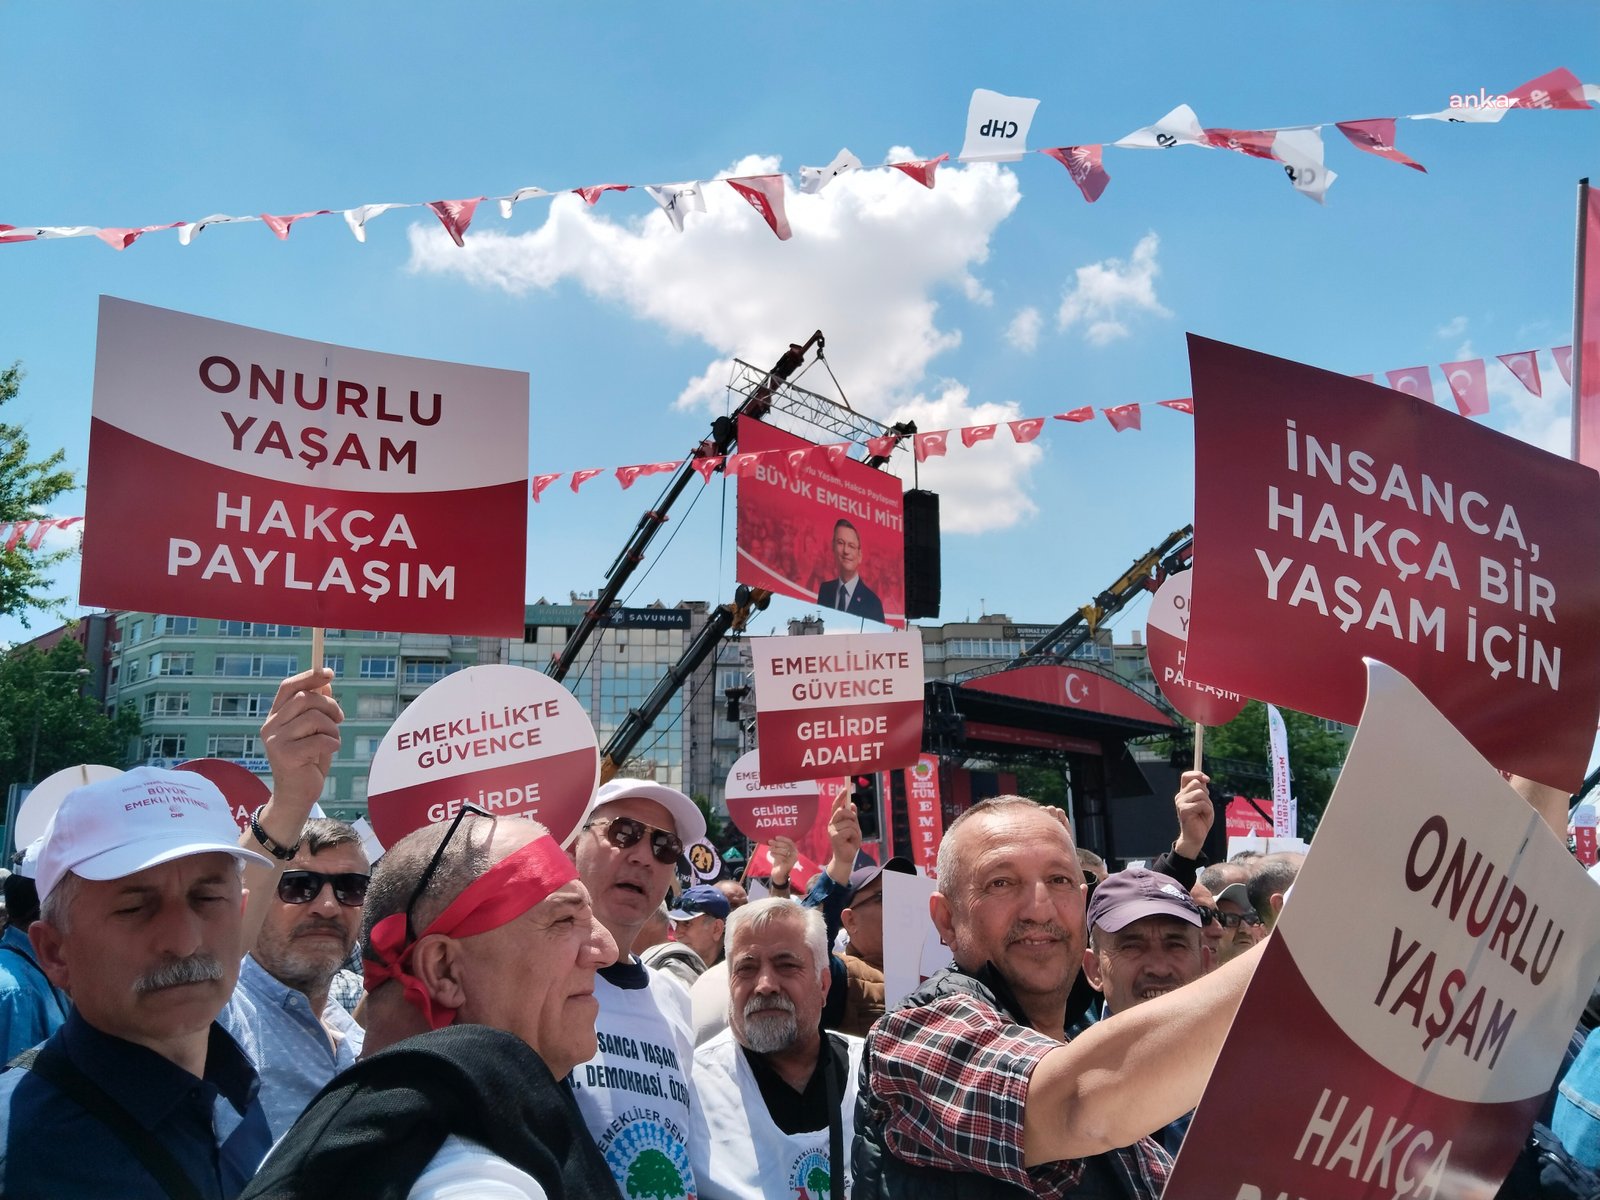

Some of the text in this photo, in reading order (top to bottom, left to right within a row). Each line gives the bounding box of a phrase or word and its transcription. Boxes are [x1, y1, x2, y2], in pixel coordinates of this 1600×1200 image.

[980, 119, 1018, 138] CHP
[198, 355, 443, 427] ONURLU
[220, 411, 418, 476] YAŞAM
[816, 487, 871, 521] EMEKLİ
[1285, 418, 1540, 563] İNSANCA,
[215, 491, 418, 552] HAKÇA
[167, 537, 457, 603] PAYLAŞIM
[1267, 485, 1557, 625] HAKÇA BİR
[628, 613, 684, 623] SAVUNMA
[1254, 547, 1562, 692] YAŞAM İÇİN
[771, 649, 910, 676] EMEKLİLİKTE
[792, 678, 894, 701] GÜVENCE
[397, 699, 560, 751] EMEKLİLİKTE
[797, 715, 888, 741] GELİRDE
[417, 727, 543, 769] GÜVENCE
[800, 741, 885, 768] ADALET
[124, 794, 170, 811] EMEKLİ
[147, 785, 189, 796] BÜYÜK
[911, 788, 935, 799] TÜM
[752, 804, 799, 817] GELİRDE
[755, 816, 798, 828] ADALET
[1404, 815, 1565, 987] ONURLU
[1373, 926, 1518, 1071] YAŞAM
[585, 1064, 668, 1100] DEMOKRASİ,
[598, 1105, 661, 1154] EMEKLİLER
[1293, 1087, 1455, 1200] HAKÇA
